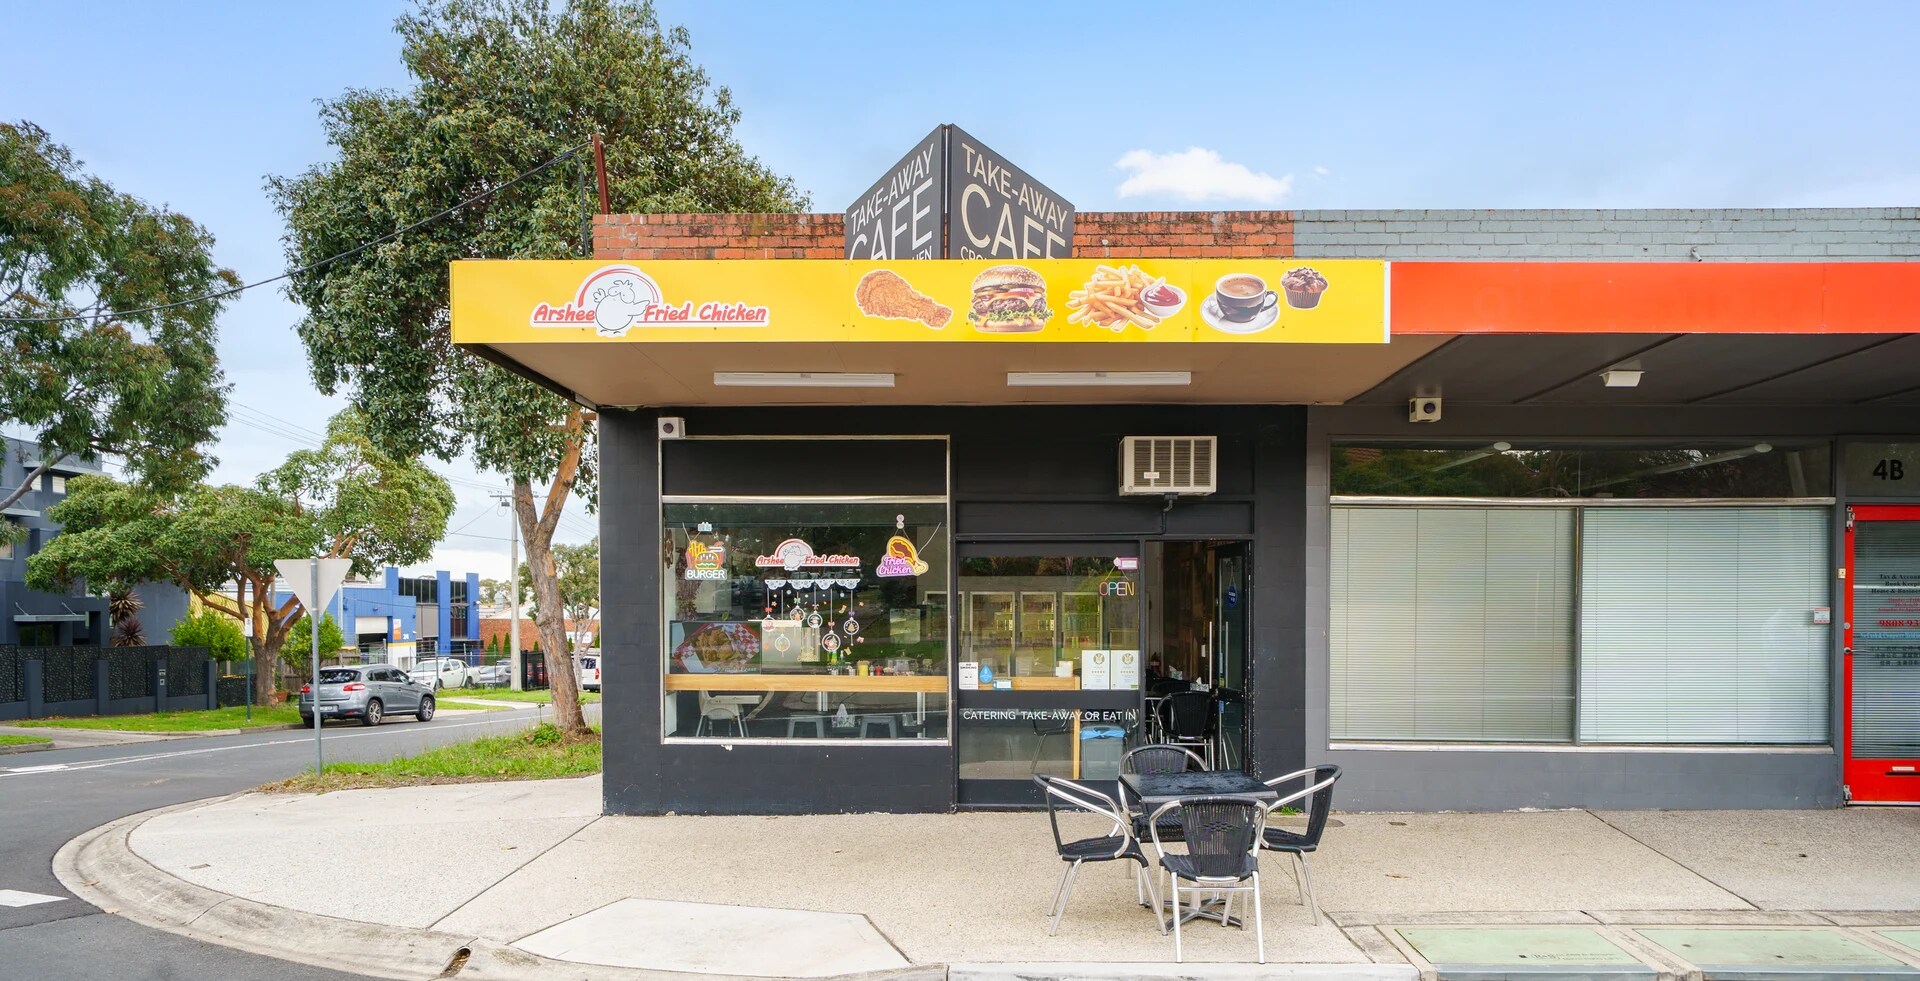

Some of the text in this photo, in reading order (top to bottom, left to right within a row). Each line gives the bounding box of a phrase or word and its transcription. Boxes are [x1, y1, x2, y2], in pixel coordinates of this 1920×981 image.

[851, 143, 934, 235] TAKE-AWAY
[961, 142, 1068, 232] TAKE-AWAY
[534, 303, 766, 321] Arshee Fried Chicken
[1873, 459, 1904, 480] 4B
[757, 556, 858, 564] Arshee Fried Chicken
[883, 556, 906, 565] Fried
[687, 569, 725, 579] BURGER
[879, 565, 911, 575] Chicken
[1099, 581, 1135, 596] OPEN
[963, 711, 1136, 720] CATERING TAKE-AWAY OR EAT IN
